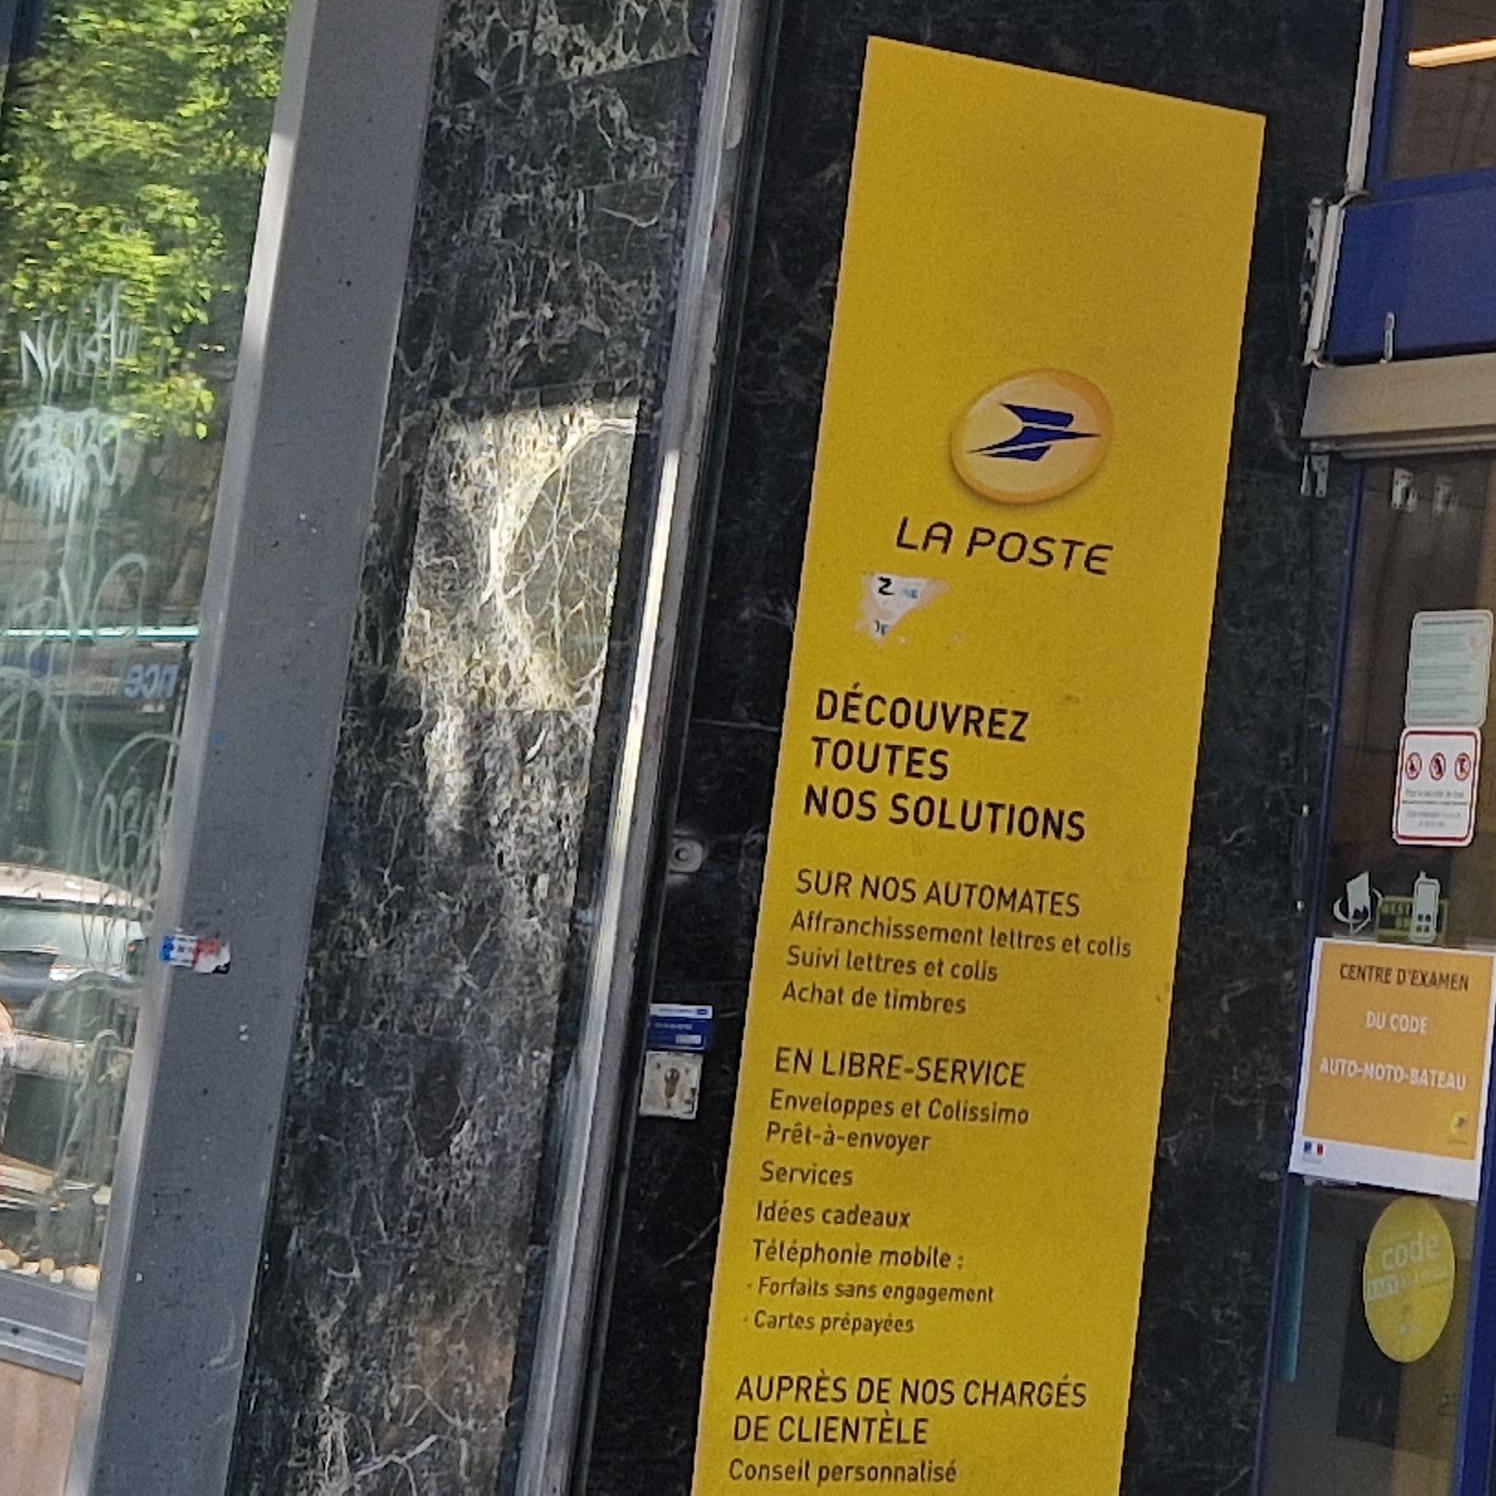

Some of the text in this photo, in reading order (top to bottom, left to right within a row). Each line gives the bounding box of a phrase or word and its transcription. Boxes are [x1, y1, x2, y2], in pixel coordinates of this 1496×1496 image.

[895, 516, 1114, 576] LA POSTE
[816, 682, 1029, 742] DÉCOUVREZ
[812, 736, 949, 780] TOUTES
[804, 784, 1086, 842] NOS SOLUTIONS
[796, 869, 1080, 918] SUR NOS AUTOMATES
[790, 910, 1132, 958] Affranchissement lettres et colis
[787, 944, 999, 982] Suivi lettres et colis
[1340, 963, 1469, 991] CENTRE D'EXAMEN
[782, 979, 966, 1014] Achat de timbres
[1366, 1011, 1427, 1035] DU CODE
[775, 1047, 1026, 1087] EN LIBRE-SERVICE
[1320, 1057, 1466, 1091] AUTO-MOTO-BATEAU
[770, 1088, 1029, 1125] Enveloppes et Colissimo
[766, 1121, 931, 1156] Prêt-à-envoyer
[760, 1160, 854, 1186] Services
[756, 1199, 911, 1228] Idées cadeaux
[752, 1238, 872, 1268] Téléphonie
[879, 1245, 952, 1269] mobile
[757, 1276, 994, 1305] Forfaits sans engagement
[753, 1309, 914, 1335] Cartes prépayées
[735, 1369, 1087, 1408] AUPRÈS DE NOS CHARGÉS
[733, 1408, 929, 1445] DE CLIENTÈLE
[729, 1457, 957, 1487] Conseil personnalisé
